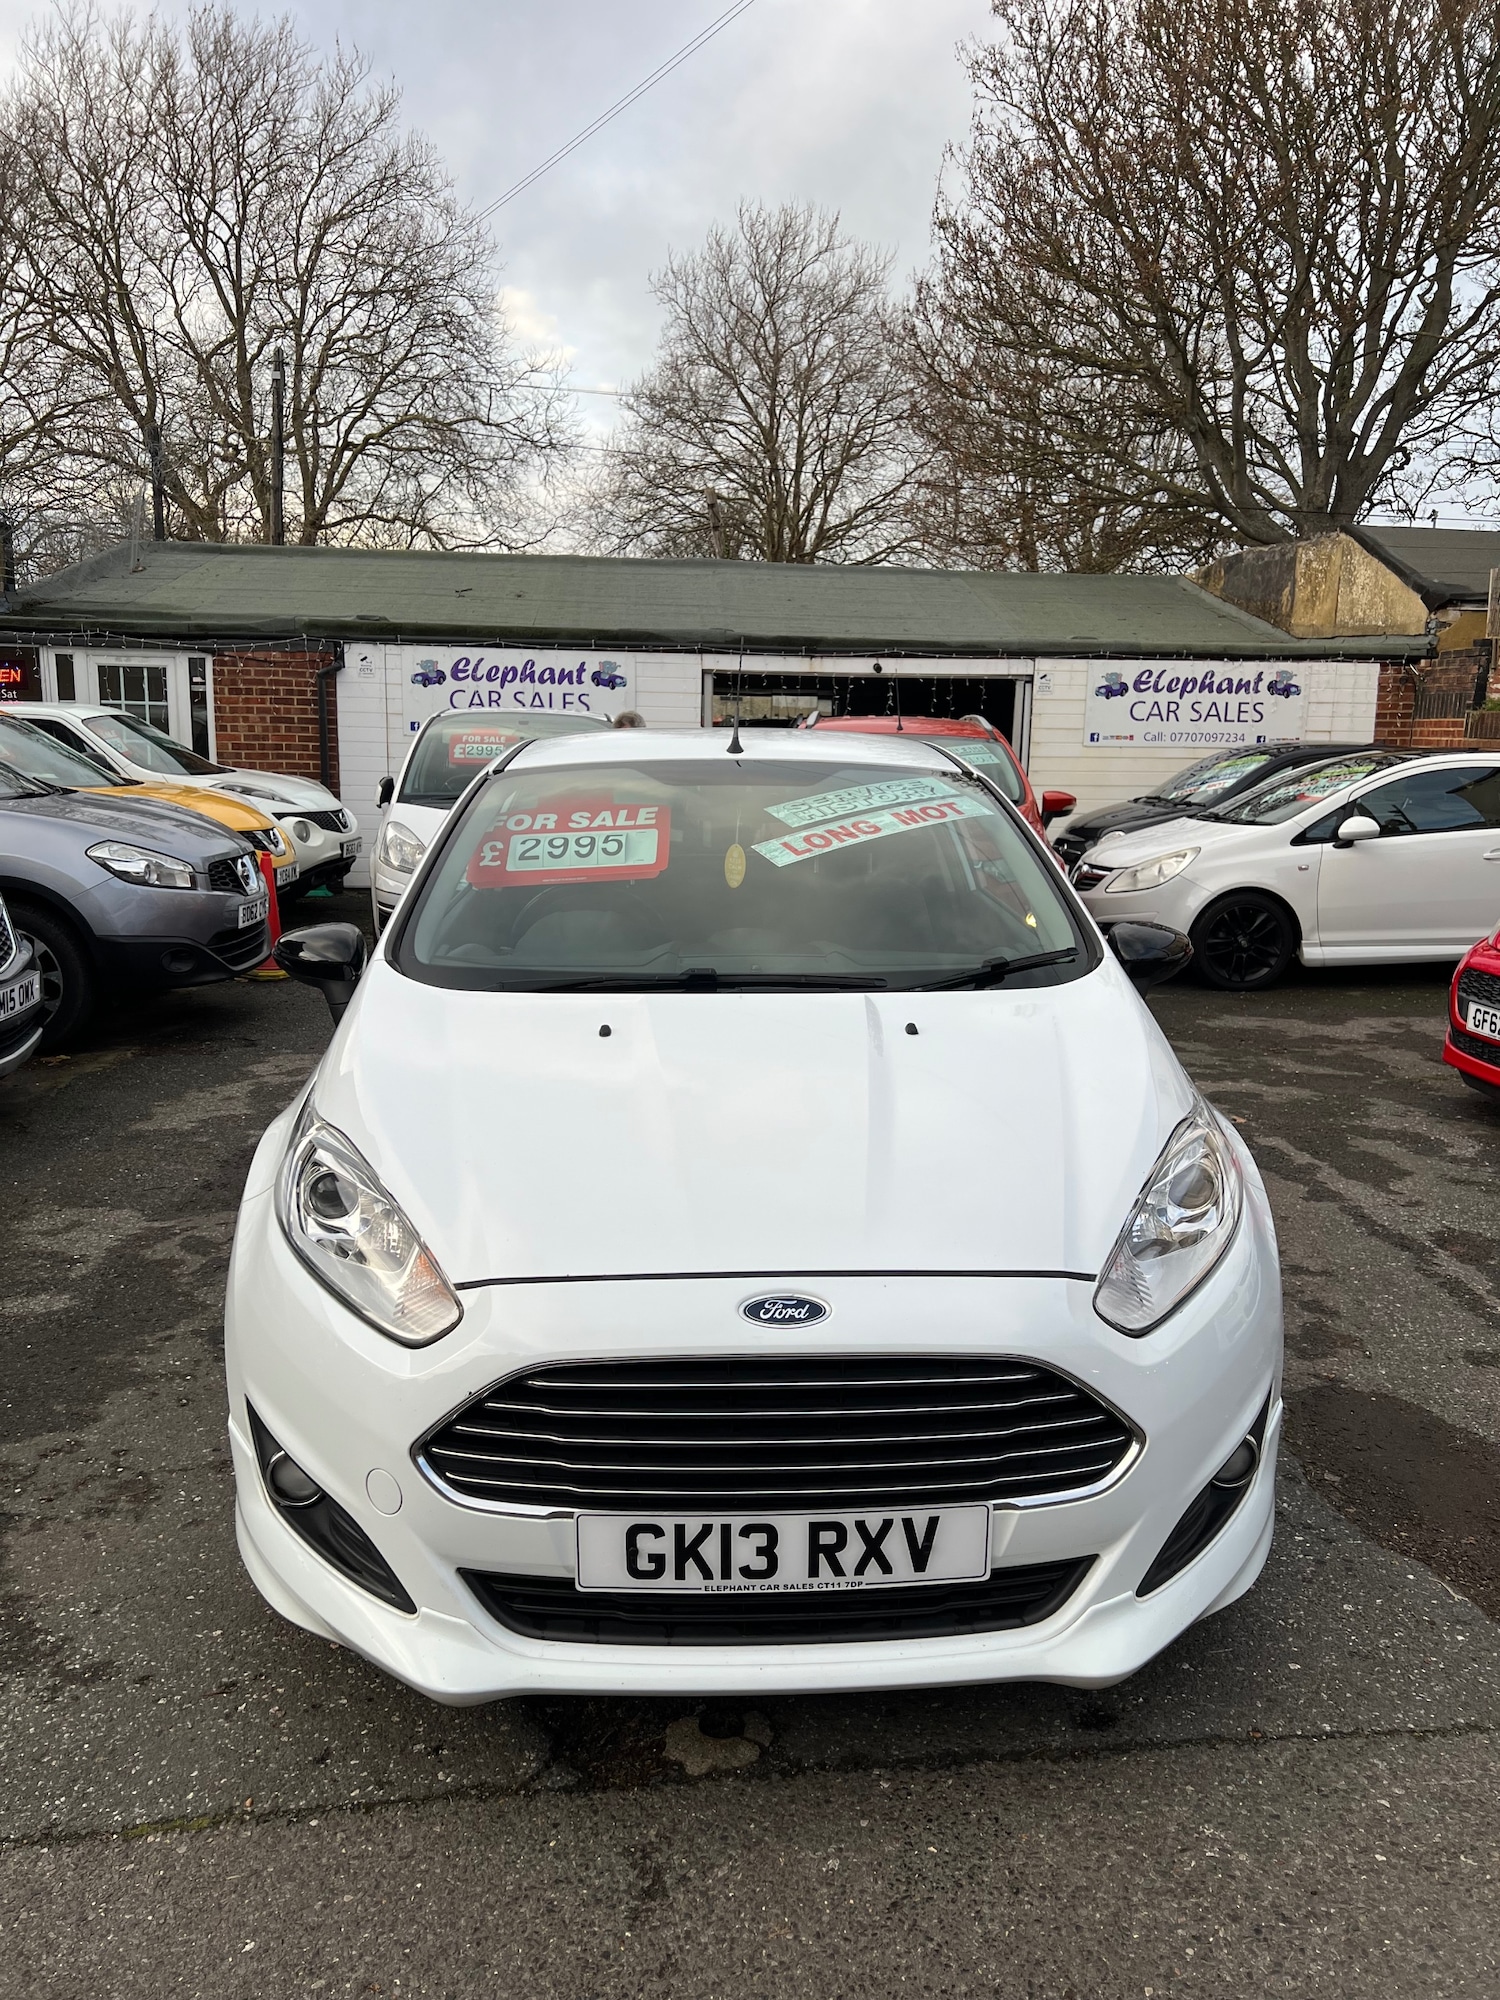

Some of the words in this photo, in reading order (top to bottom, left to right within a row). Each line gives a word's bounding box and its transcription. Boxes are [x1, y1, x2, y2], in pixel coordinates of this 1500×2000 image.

[450, 657, 586, 690] Elephant
[1133, 669, 1264, 700] Elephant
[1, 689, 18, 699] Sat
[450, 689, 502, 710] CAR
[513, 691, 590, 712] SALES
[1129, 700, 1180, 723] CAR
[1190, 701, 1265, 723] SALES
[462, 735, 482, 743] FOR
[484, 735, 507, 743] SALE
[1143, 731, 1167, 742] Call:
[1170, 732, 1245, 743] 07707097234
[783, 780, 927, 812] SERVICE
[792, 786, 938, 821] HISTORY
[485, 814, 558, 833] FOR
[568, 806, 659, 829] SALE
[779, 820, 883, 857] LONG
[890, 801, 966, 826] MOT
[517, 834, 624, 861] 2995
[1472, 1007, 1500, 1036] GF6
[760, 1300, 810, 1320] Ford
[625, 1523, 779, 1581] GK13
[808, 1515, 940, 1579] RXV
[704, 1584, 757, 1592] ELEPHANT
[817, 1582, 841, 1590] CT11
